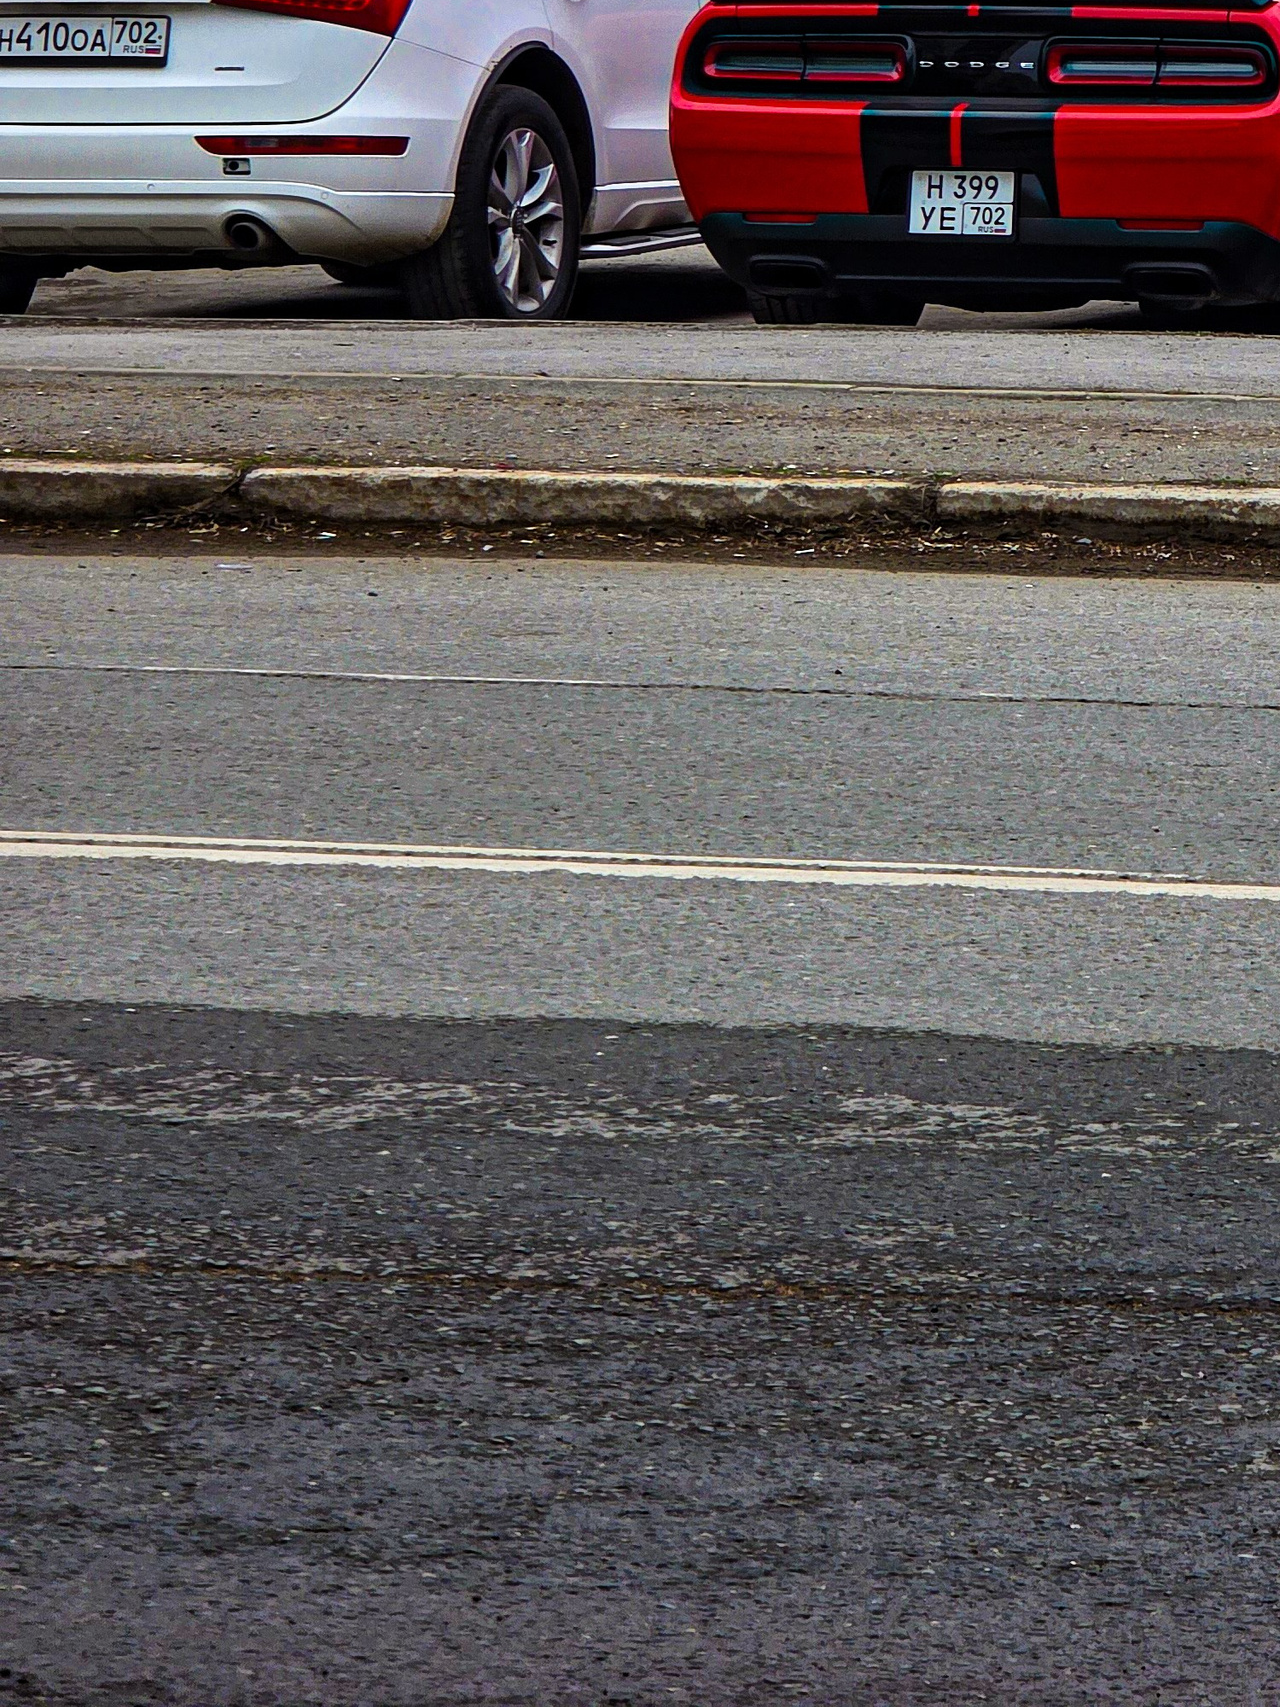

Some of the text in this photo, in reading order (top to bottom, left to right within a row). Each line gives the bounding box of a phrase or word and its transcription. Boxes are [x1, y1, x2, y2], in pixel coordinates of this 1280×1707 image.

[114, 21, 158, 44] 702
[122, 45, 144, 54] RUS
[919, 60, 1035, 69] DODGE
[953, 175, 999, 200] 399
[970, 206, 1006, 226] 702
